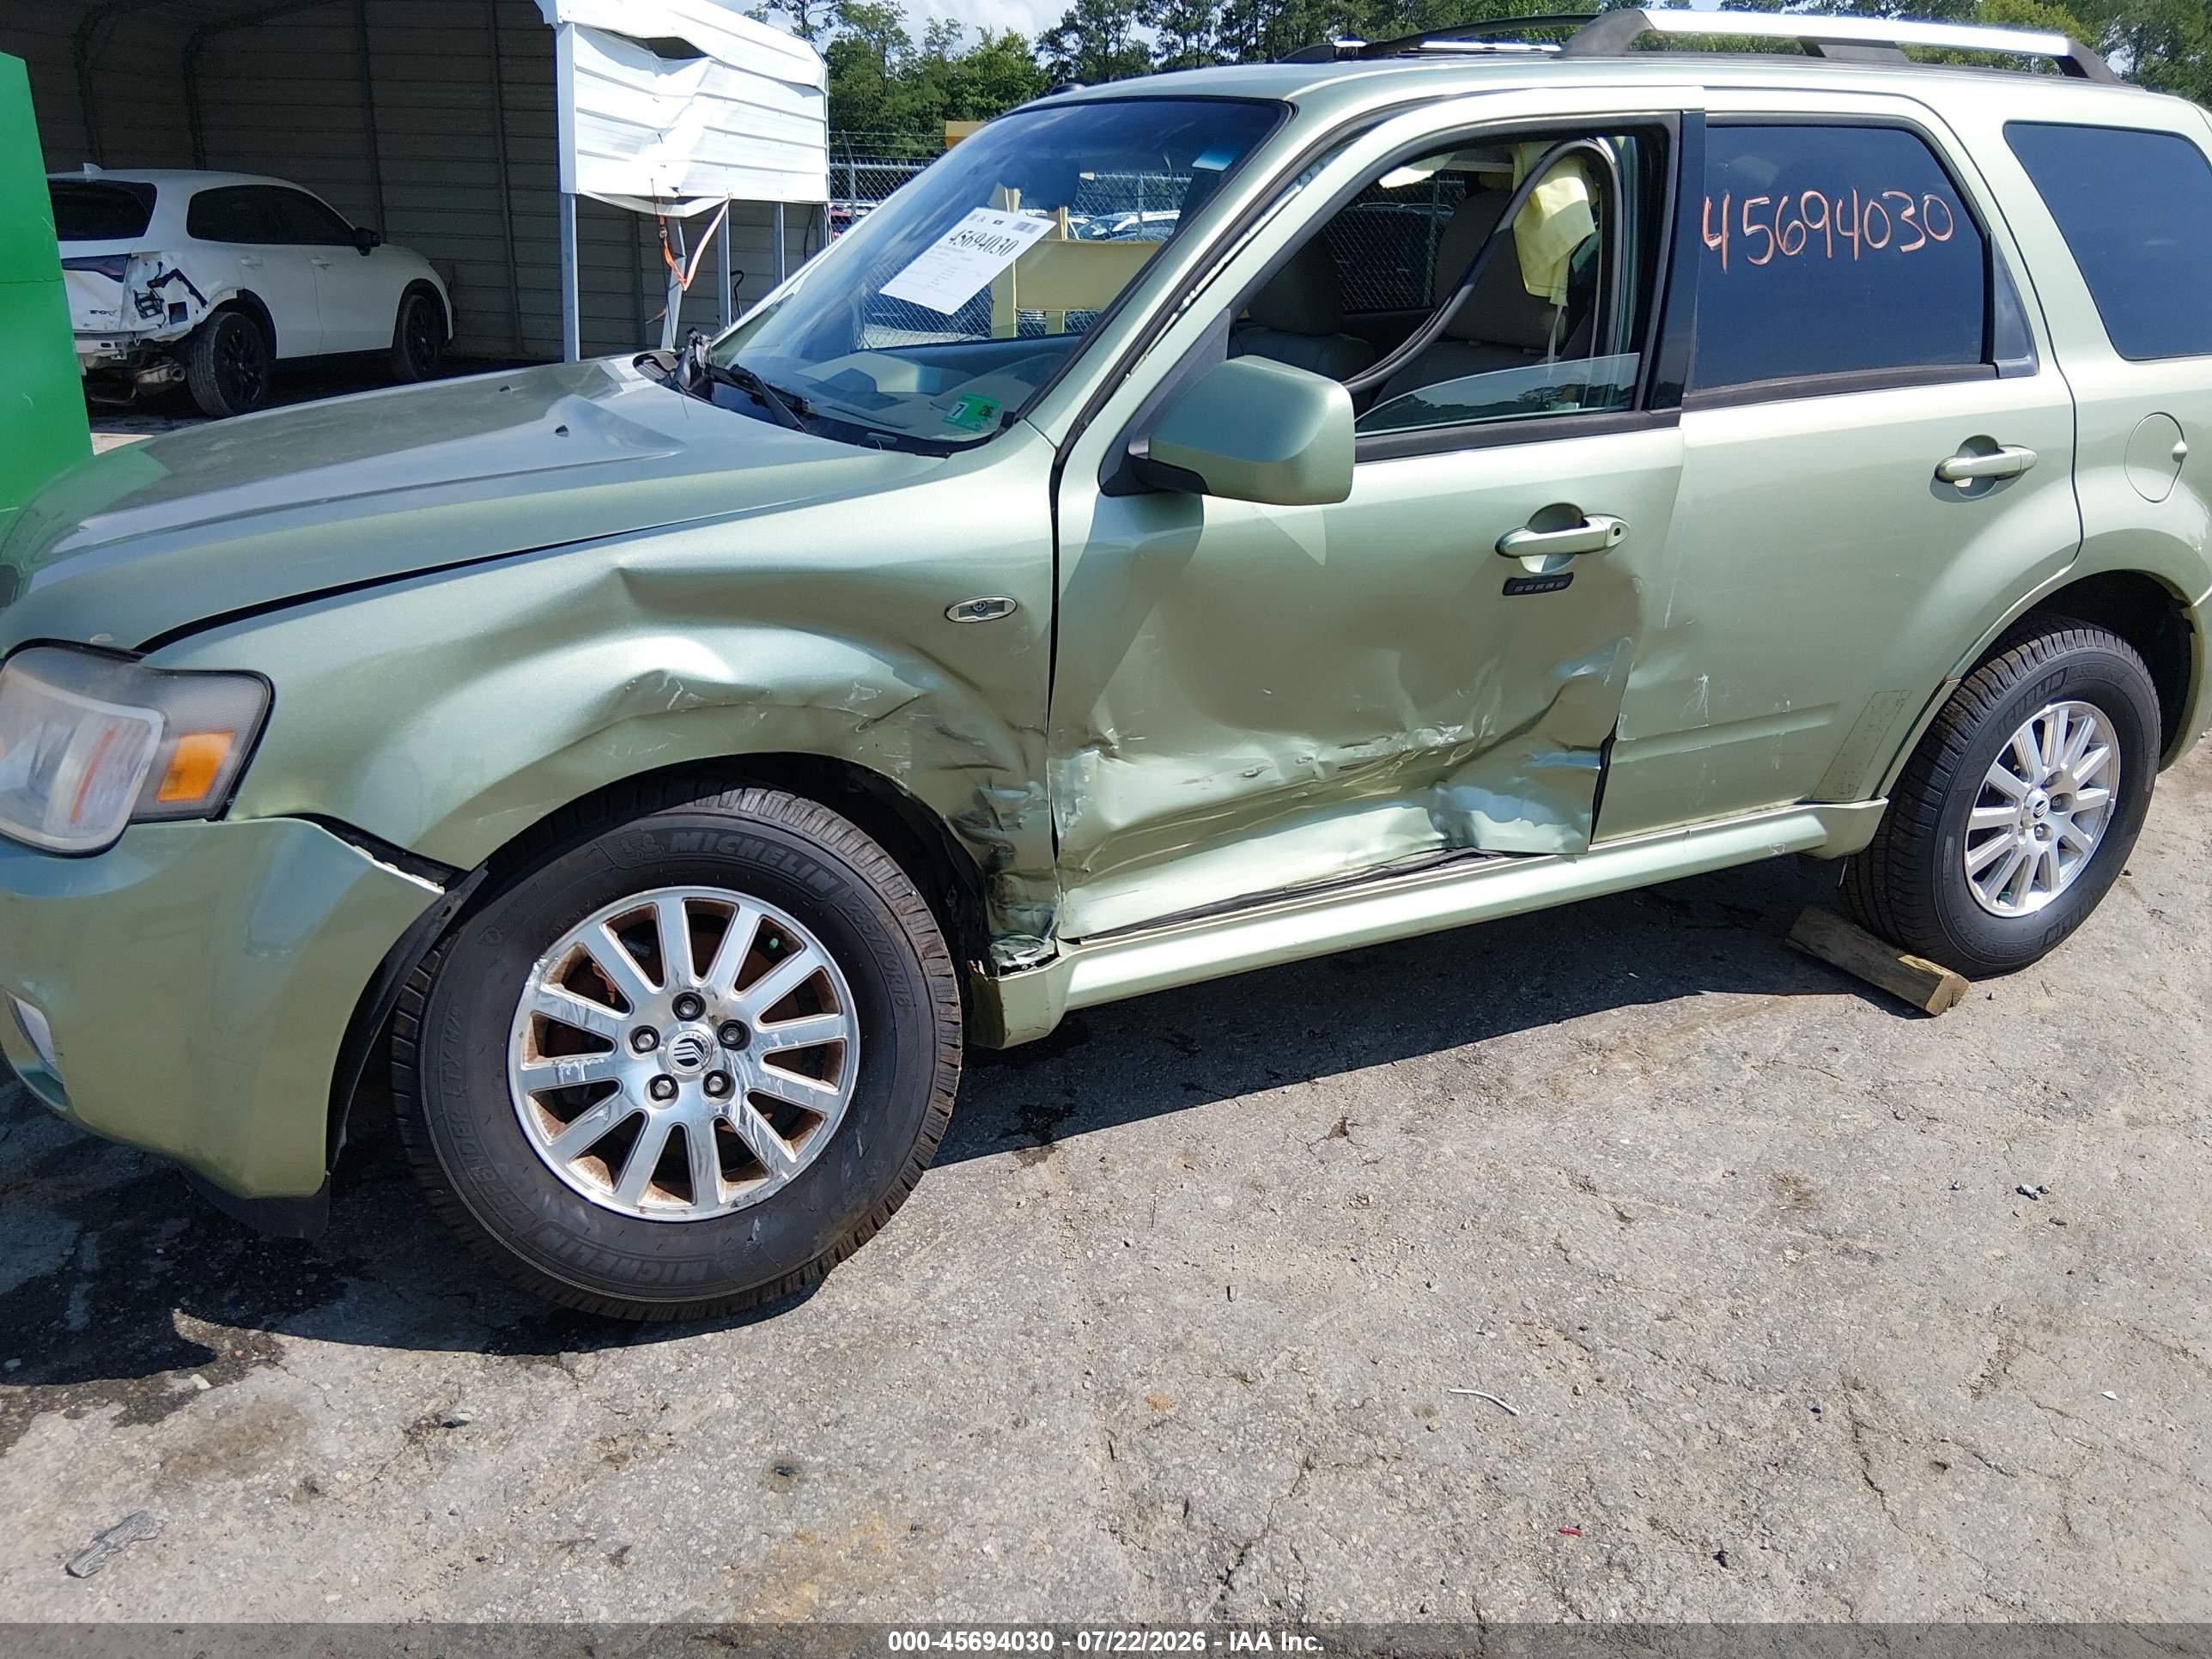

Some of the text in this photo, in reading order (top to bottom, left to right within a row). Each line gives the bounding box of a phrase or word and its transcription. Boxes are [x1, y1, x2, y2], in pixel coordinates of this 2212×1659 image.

[949, 229, 1019, 257] 45694030
[1702, 187, 1954, 274] 45694030
[670, 831, 840, 893] MICHELIN
[534, 1226, 710, 1283] MICHELIN
